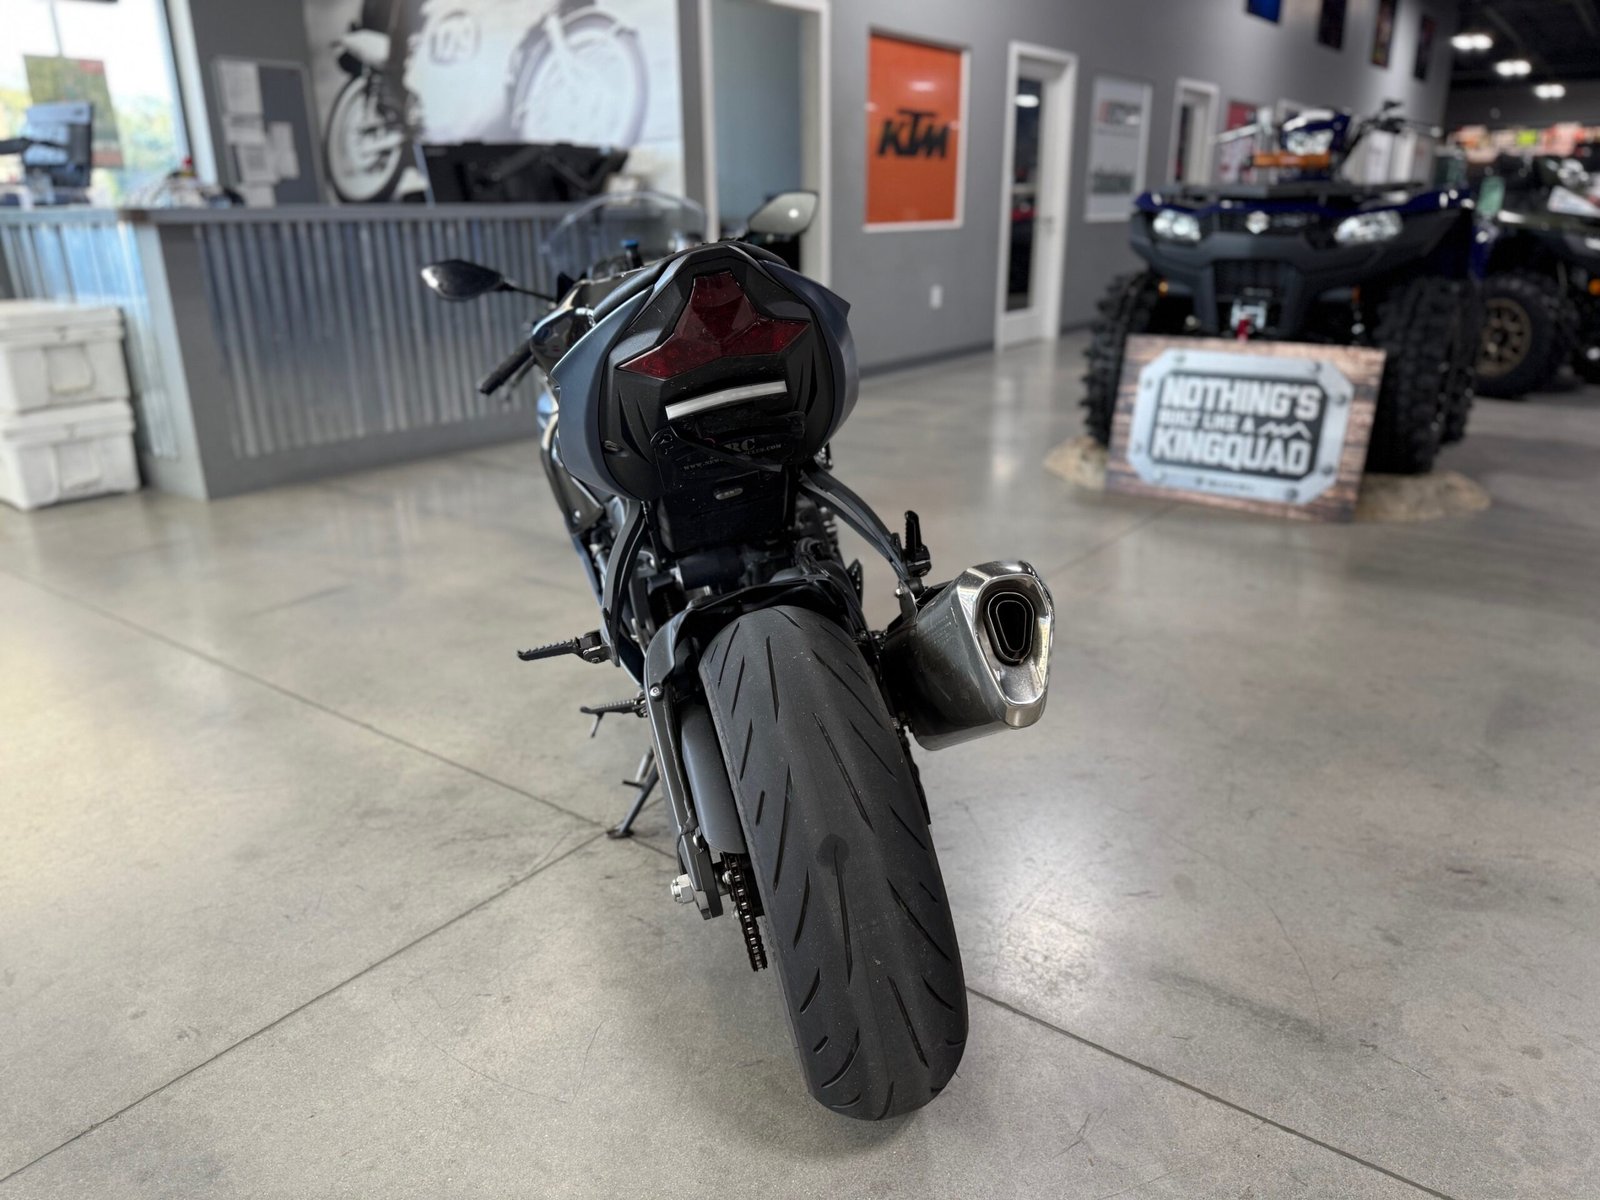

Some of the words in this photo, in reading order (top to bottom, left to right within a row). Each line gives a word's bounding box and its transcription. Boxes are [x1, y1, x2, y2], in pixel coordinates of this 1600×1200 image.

[878, 107, 949, 159] KTM
[1160, 374, 1324, 421] NOTHING'S
[1201, 412, 1239, 432] LIKE
[1240, 416, 1256, 434] A
[1152, 427, 1312, 476] KINGQUAD
